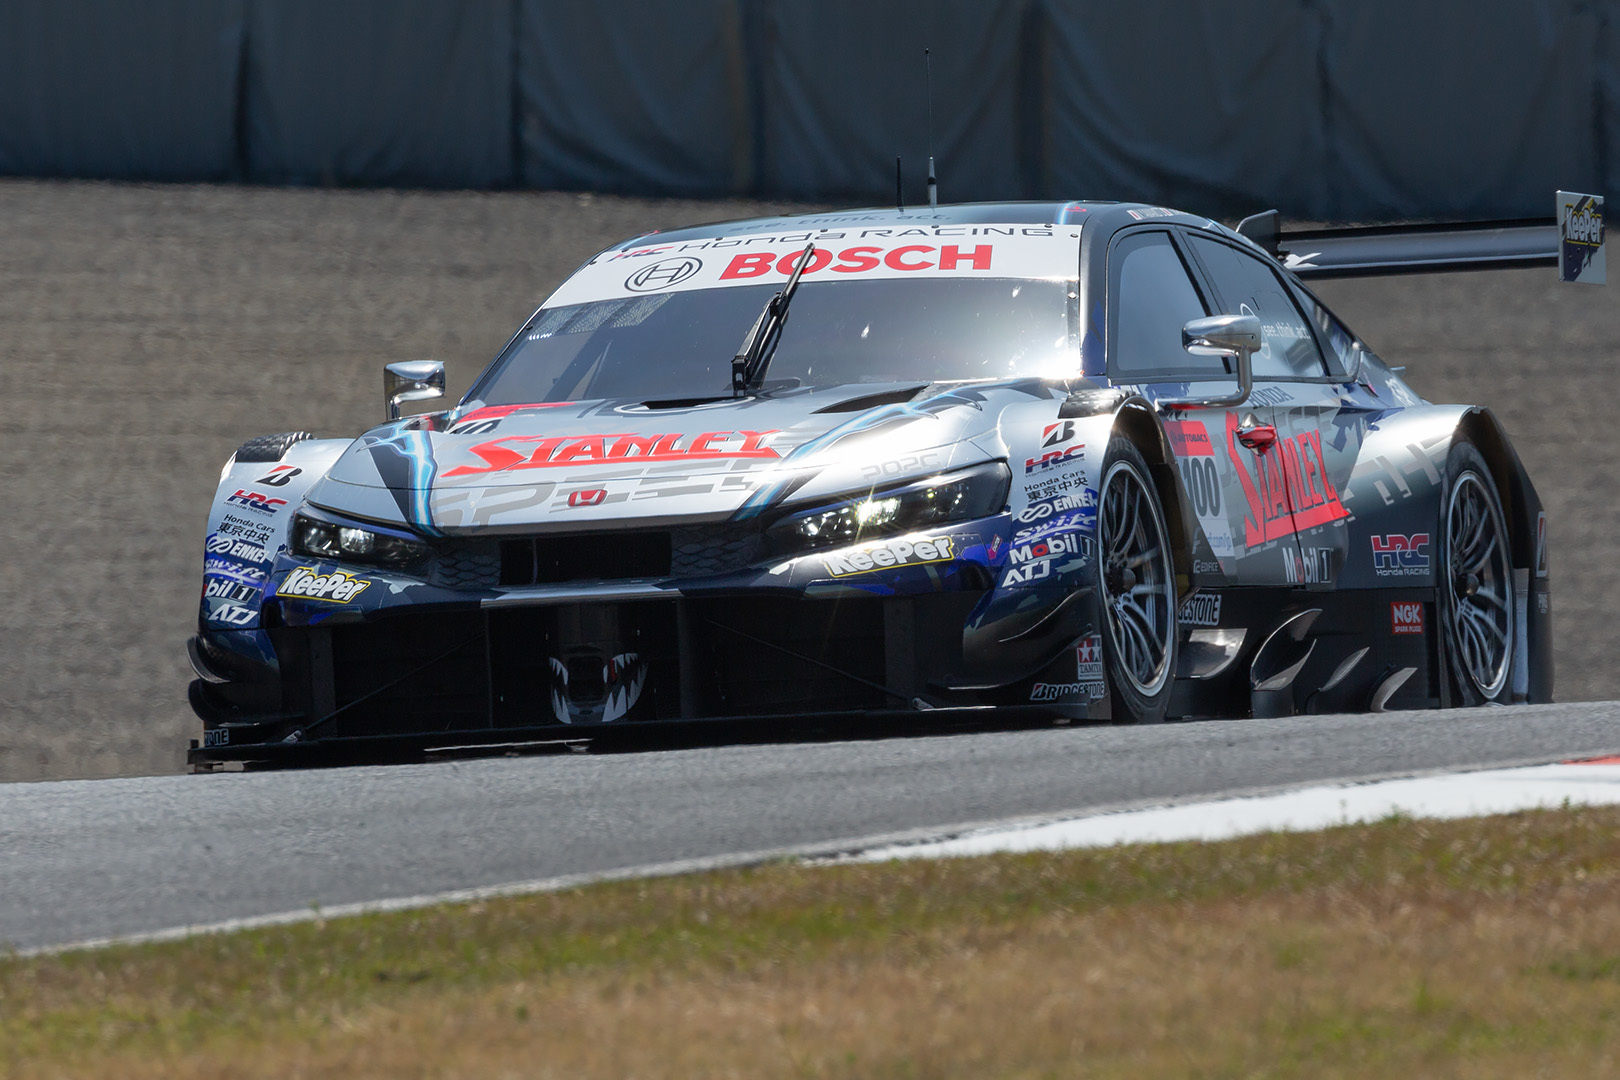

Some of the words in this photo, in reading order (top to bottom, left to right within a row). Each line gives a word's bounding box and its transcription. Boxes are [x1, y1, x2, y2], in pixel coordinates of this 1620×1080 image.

[1566, 205, 1601, 243] KeePer
[678, 231, 846, 253] Honda
[860, 226, 1054, 239] RACING
[718, 244, 993, 280] BOSCH
[1248, 386, 1295, 409] HONDA
[440, 428, 785, 478] STANLEY
[1025, 443, 1086, 474] HRC
[1024, 477, 1060, 492] Honda
[1061, 469, 1086, 480] Cars
[1027, 476, 1089, 503] 東京中央
[227, 489, 288, 514] HRC
[216, 521, 270, 545] 東京中央
[223, 513, 255, 528] Honda
[255, 522, 276, 534] Cars
[229, 539, 270, 565] ENKEI
[825, 537, 951, 576] KeePer
[1009, 533, 1078, 565] Mobil
[1371, 533, 1430, 568] HRC
[1002, 559, 1051, 588] ATJ
[1282, 546, 1319, 584] Mobil
[1376, 568, 1404, 577] Honda
[1404, 568, 1430, 576] RACING
[279, 567, 369, 602] KeePer
[208, 602, 259, 625] ATJ
[1393, 604, 1422, 624] NGK
